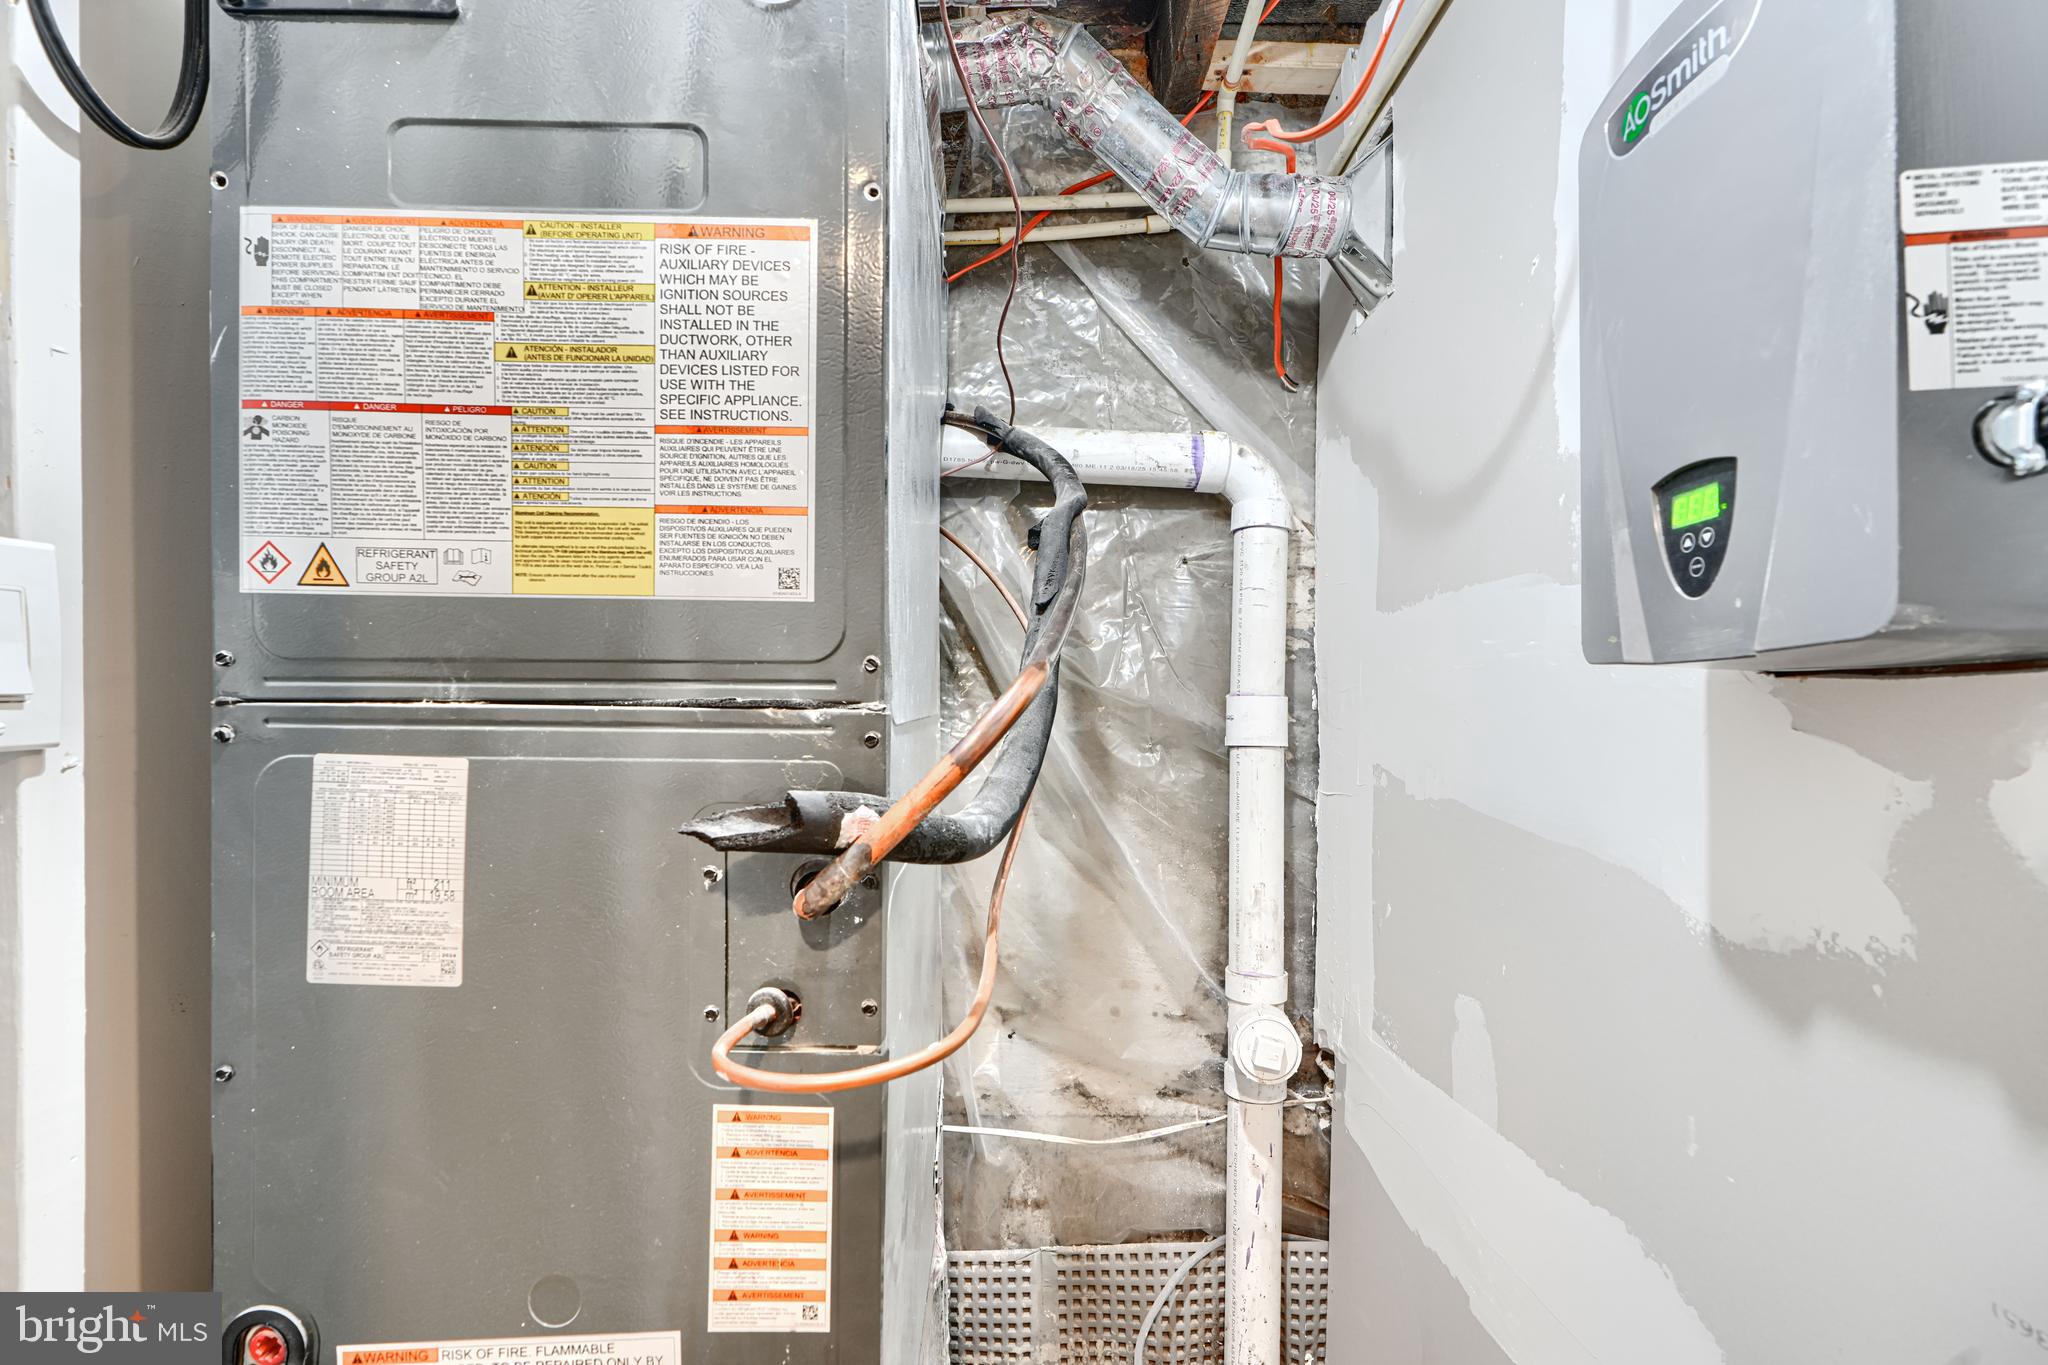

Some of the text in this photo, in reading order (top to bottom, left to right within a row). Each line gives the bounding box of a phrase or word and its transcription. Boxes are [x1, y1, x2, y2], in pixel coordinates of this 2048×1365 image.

[575, 231, 620, 239] OPERATING
[701, 226, 764, 238] WARNING
[660, 243, 690, 254] RISK
[694, 244, 712, 254] OF
[717, 244, 746, 255] FIRE
[659, 258, 790, 271] AUXILIARY DEVICES
[659, 273, 758, 286] WHICH MAY BE
[660, 288, 787, 301] IGNITION SOURCES
[659, 303, 702, 315] SHALL
[705, 304, 733, 315] NOT
[737, 305, 754, 316] BE
[660, 318, 779, 331] INSTALLED IN THE
[660, 333, 792, 347] DUCTWORK, OTHER
[565, 354, 610, 362] FUNCIONAR
[660, 348, 767, 361] THAN AUXILIARY
[659, 363, 799, 377] DEVICES LISTED FOR
[660, 378, 754, 390] USE WITH THE
[660, 393, 802, 407] SPECIFIC APPLIANCE.
[659, 408, 792, 421] SEE INSTRUCTIONS.
[357, 549, 434, 558] REFRIGERANT
[376, 561, 417, 570] SAFETY
[366, 573, 427, 582] GROUP A2L
[312, 876, 359, 887] MINIMUM
[434, 878, 450, 890] 211
[312, 887, 344, 898] ROOM
[347, 888, 374, 898] AREA
[744, 1113, 781, 1122] WARNING
[745, 1149, 798, 1158] ADVERTENCIA
[744, 1191, 806, 1200] AVERTISSEMENT
[743, 1232, 779, 1240] WARNING
[742, 1260, 796, 1268] ADVERTENCIA
[742, 1292, 804, 1300] AVERTISSEMENT
[364, 1350, 428, 1363] WARNING
[442, 1350, 472, 1360] RISK
[476, 1348, 494, 1359] OF
[536, 1343, 616, 1357] FLAMMABLE
